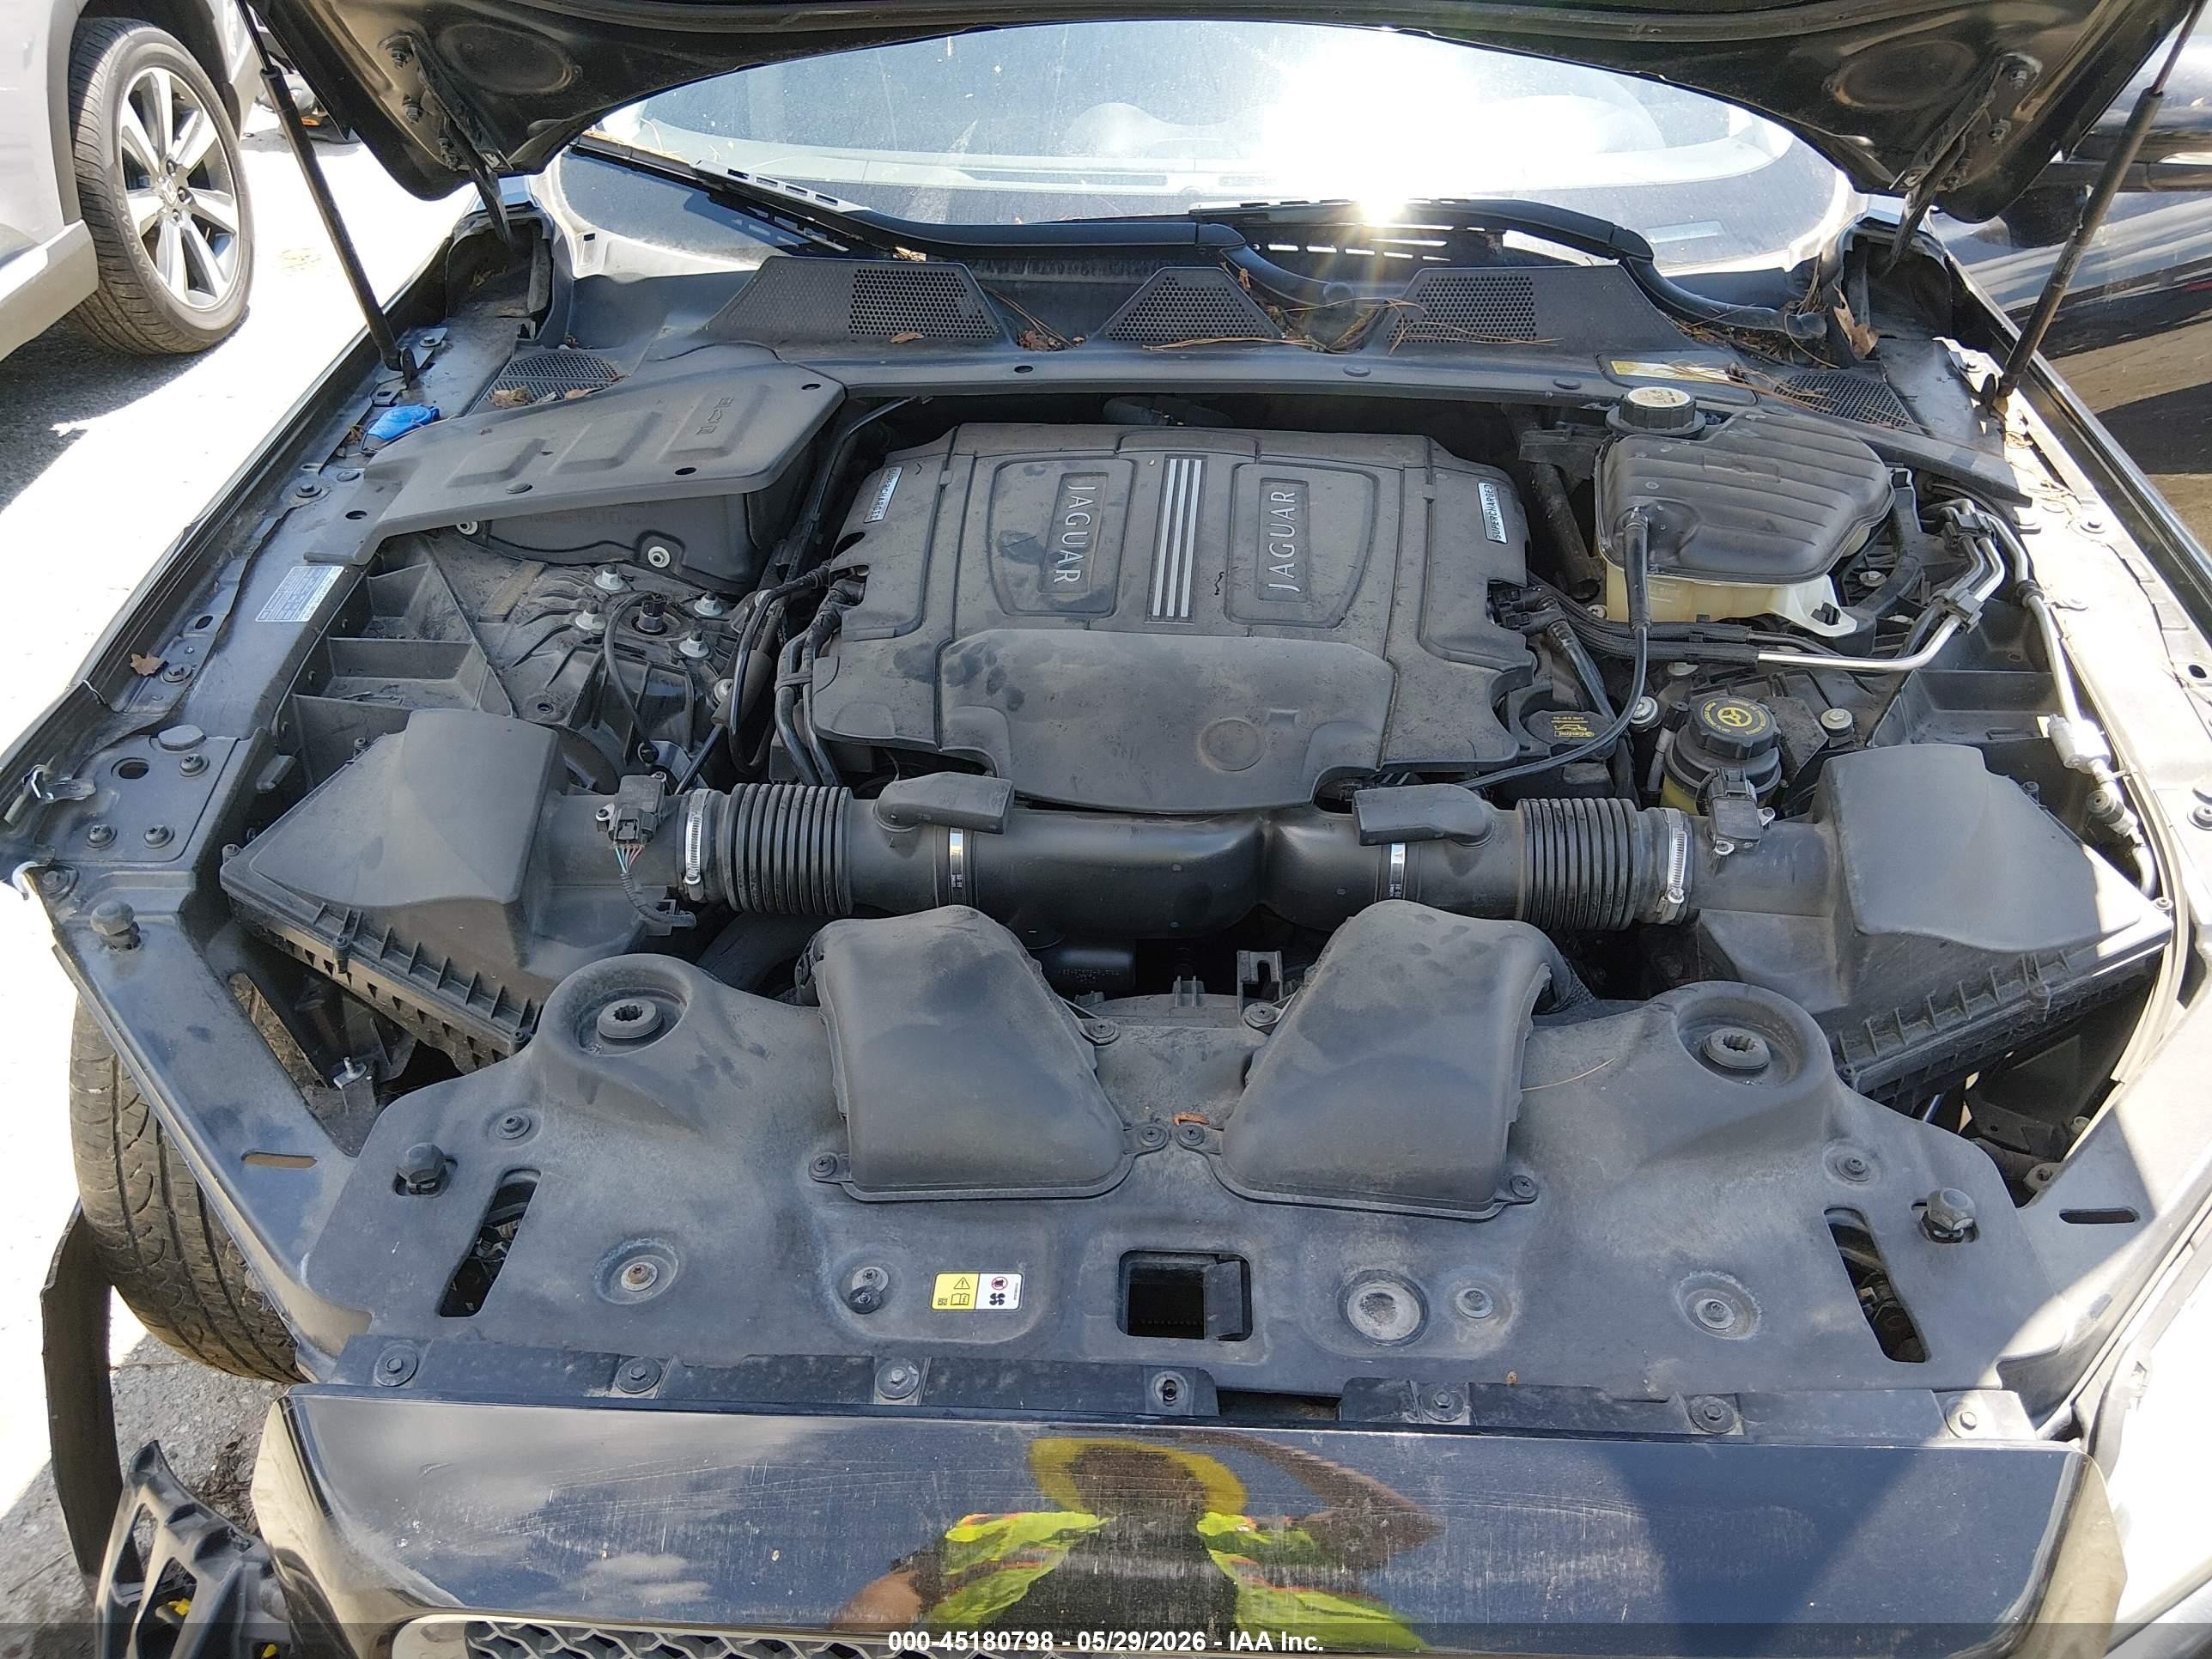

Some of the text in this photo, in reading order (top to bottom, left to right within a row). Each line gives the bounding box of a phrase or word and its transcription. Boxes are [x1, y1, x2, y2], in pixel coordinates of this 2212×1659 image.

[1054, 485, 1097, 583] JAGUAR
[1268, 491, 1300, 592] JAGUAR
[1484, 484, 1502, 539] SUPERCHARGED
